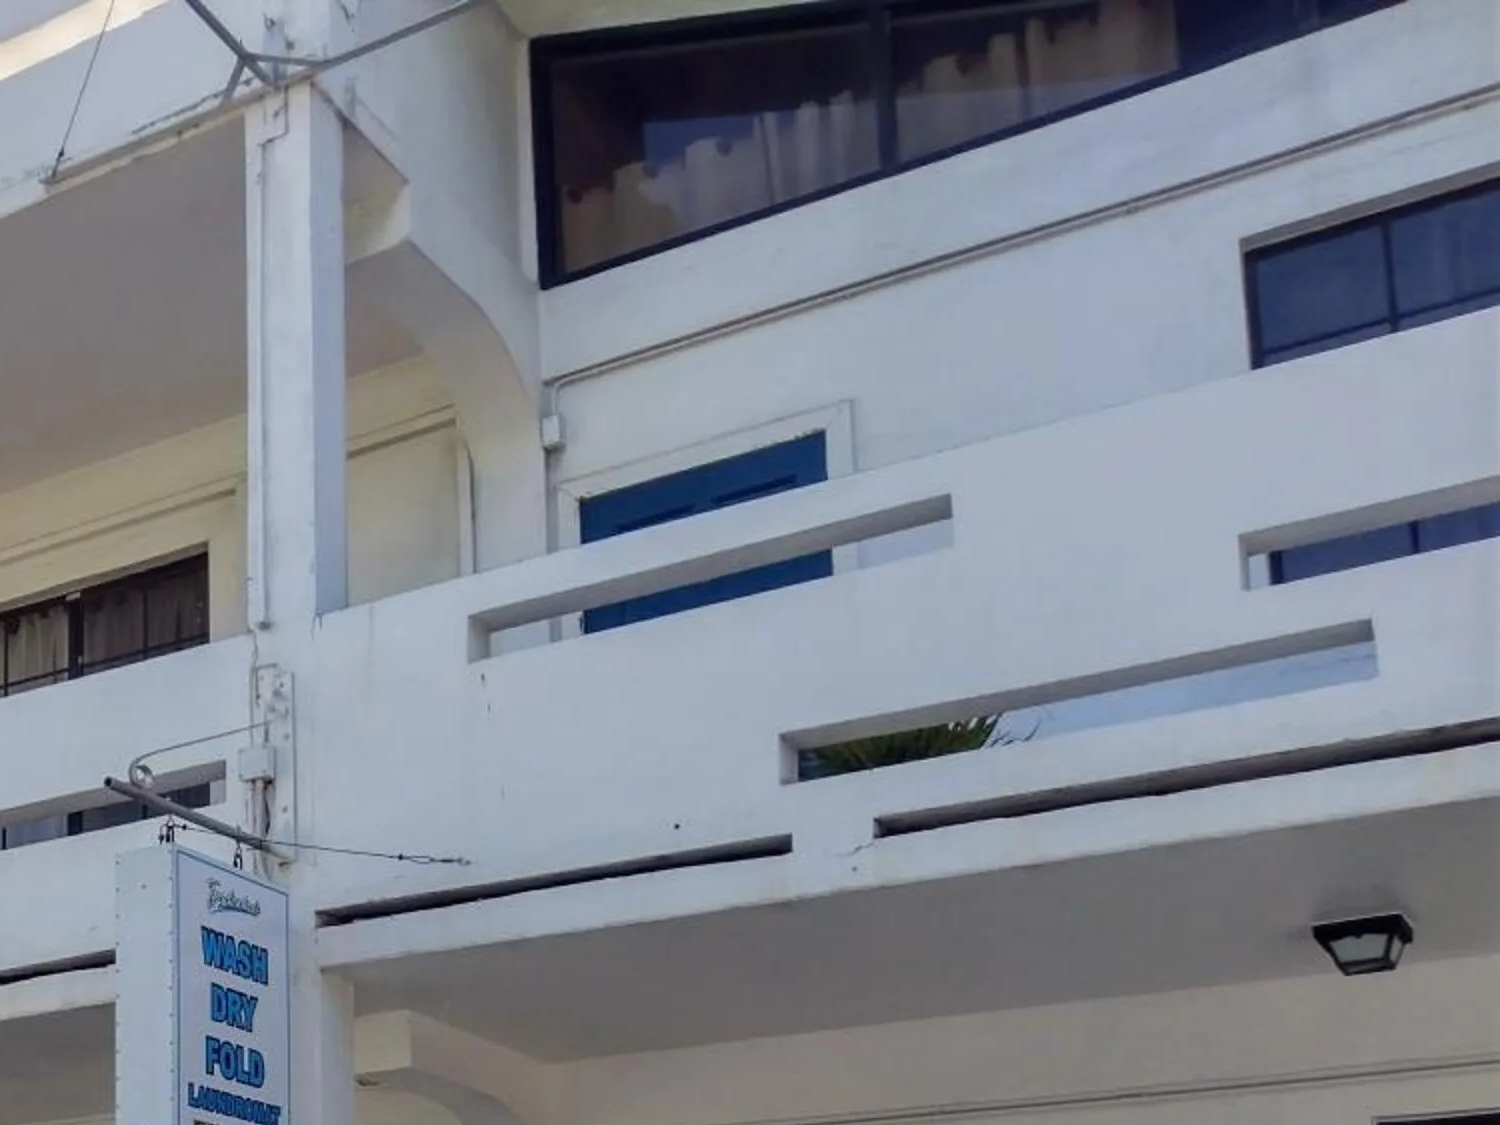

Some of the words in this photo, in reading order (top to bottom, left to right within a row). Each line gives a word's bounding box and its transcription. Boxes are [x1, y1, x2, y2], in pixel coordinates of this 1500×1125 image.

[200, 925, 269, 985] WASH
[210, 982, 258, 1033] DRY
[205, 1036, 264, 1088] FOLD
